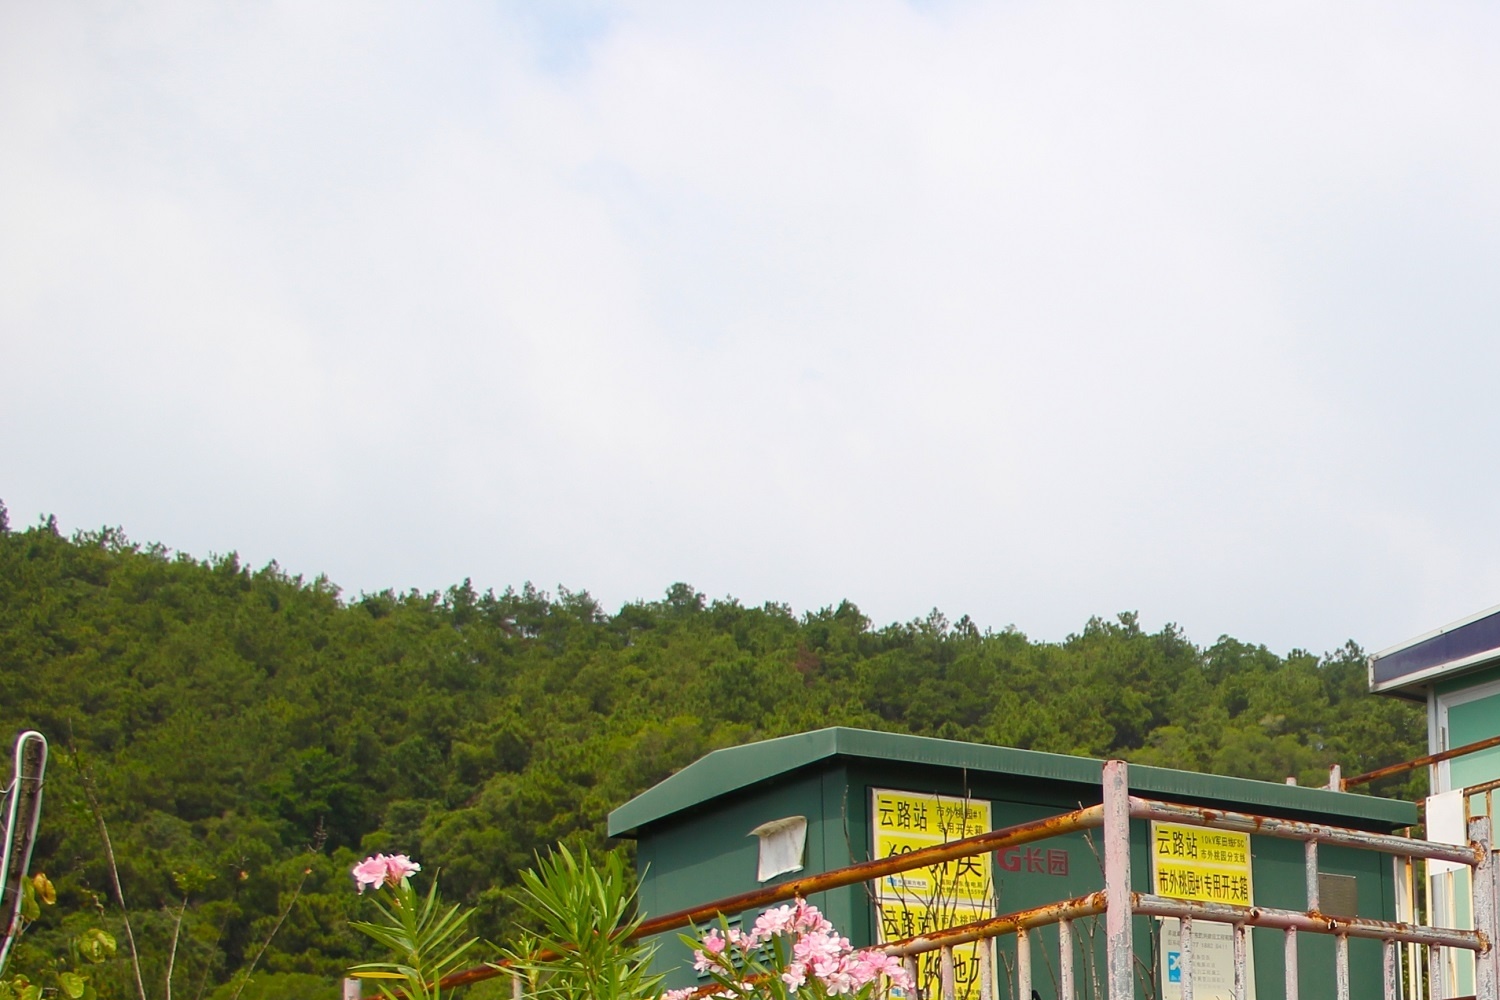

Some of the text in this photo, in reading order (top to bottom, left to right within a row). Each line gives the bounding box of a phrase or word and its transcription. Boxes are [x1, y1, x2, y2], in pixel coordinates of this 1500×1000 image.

[879, 800, 928, 832] 云路站
[1157, 830, 1198, 859] 云路站
[1201, 849, 1246, 863] 市外桃园分支线
[1159, 868, 1249, 902] 市外桃园#1专用开关箱
